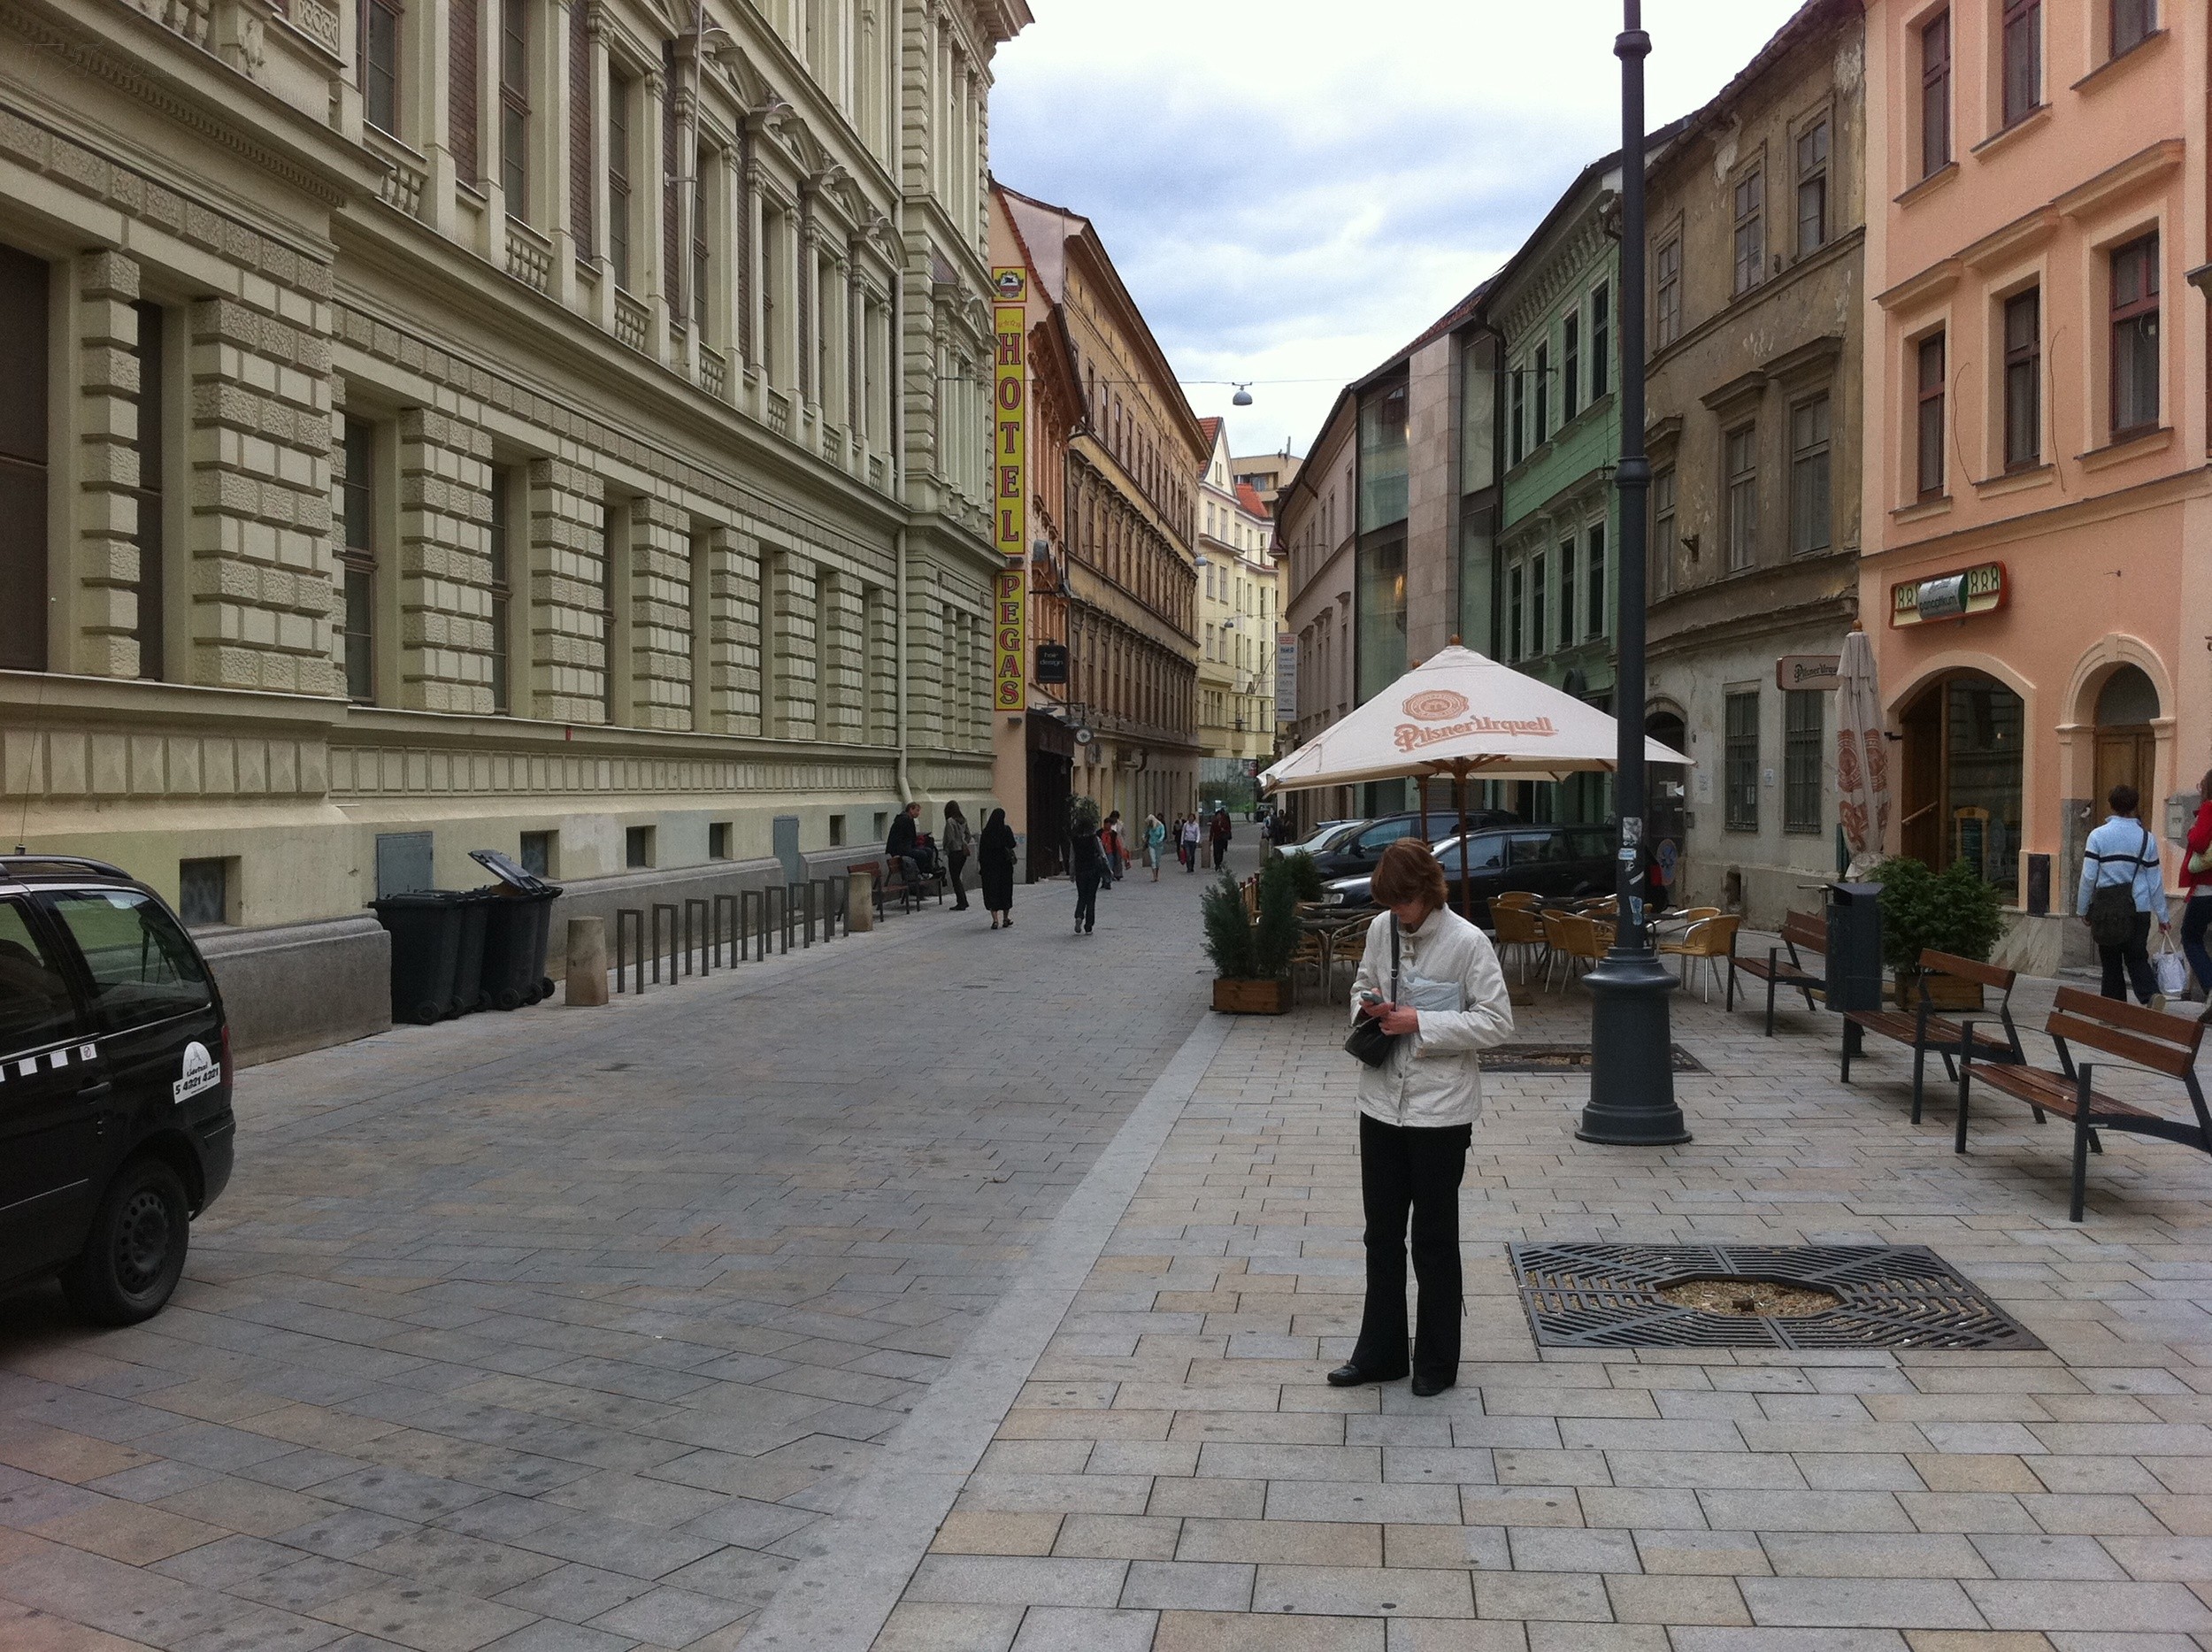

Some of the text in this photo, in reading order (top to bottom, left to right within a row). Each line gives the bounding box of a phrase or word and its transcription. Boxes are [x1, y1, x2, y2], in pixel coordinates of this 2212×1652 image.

[998, 333, 1021, 542] HOTEL
[998, 575, 1021, 705] PEGAS
[1793, 664, 1820, 683] Pilsner
[1394, 715, 1558, 752] Pilsner Urquell
[175, 1084, 181, 1095] 5
